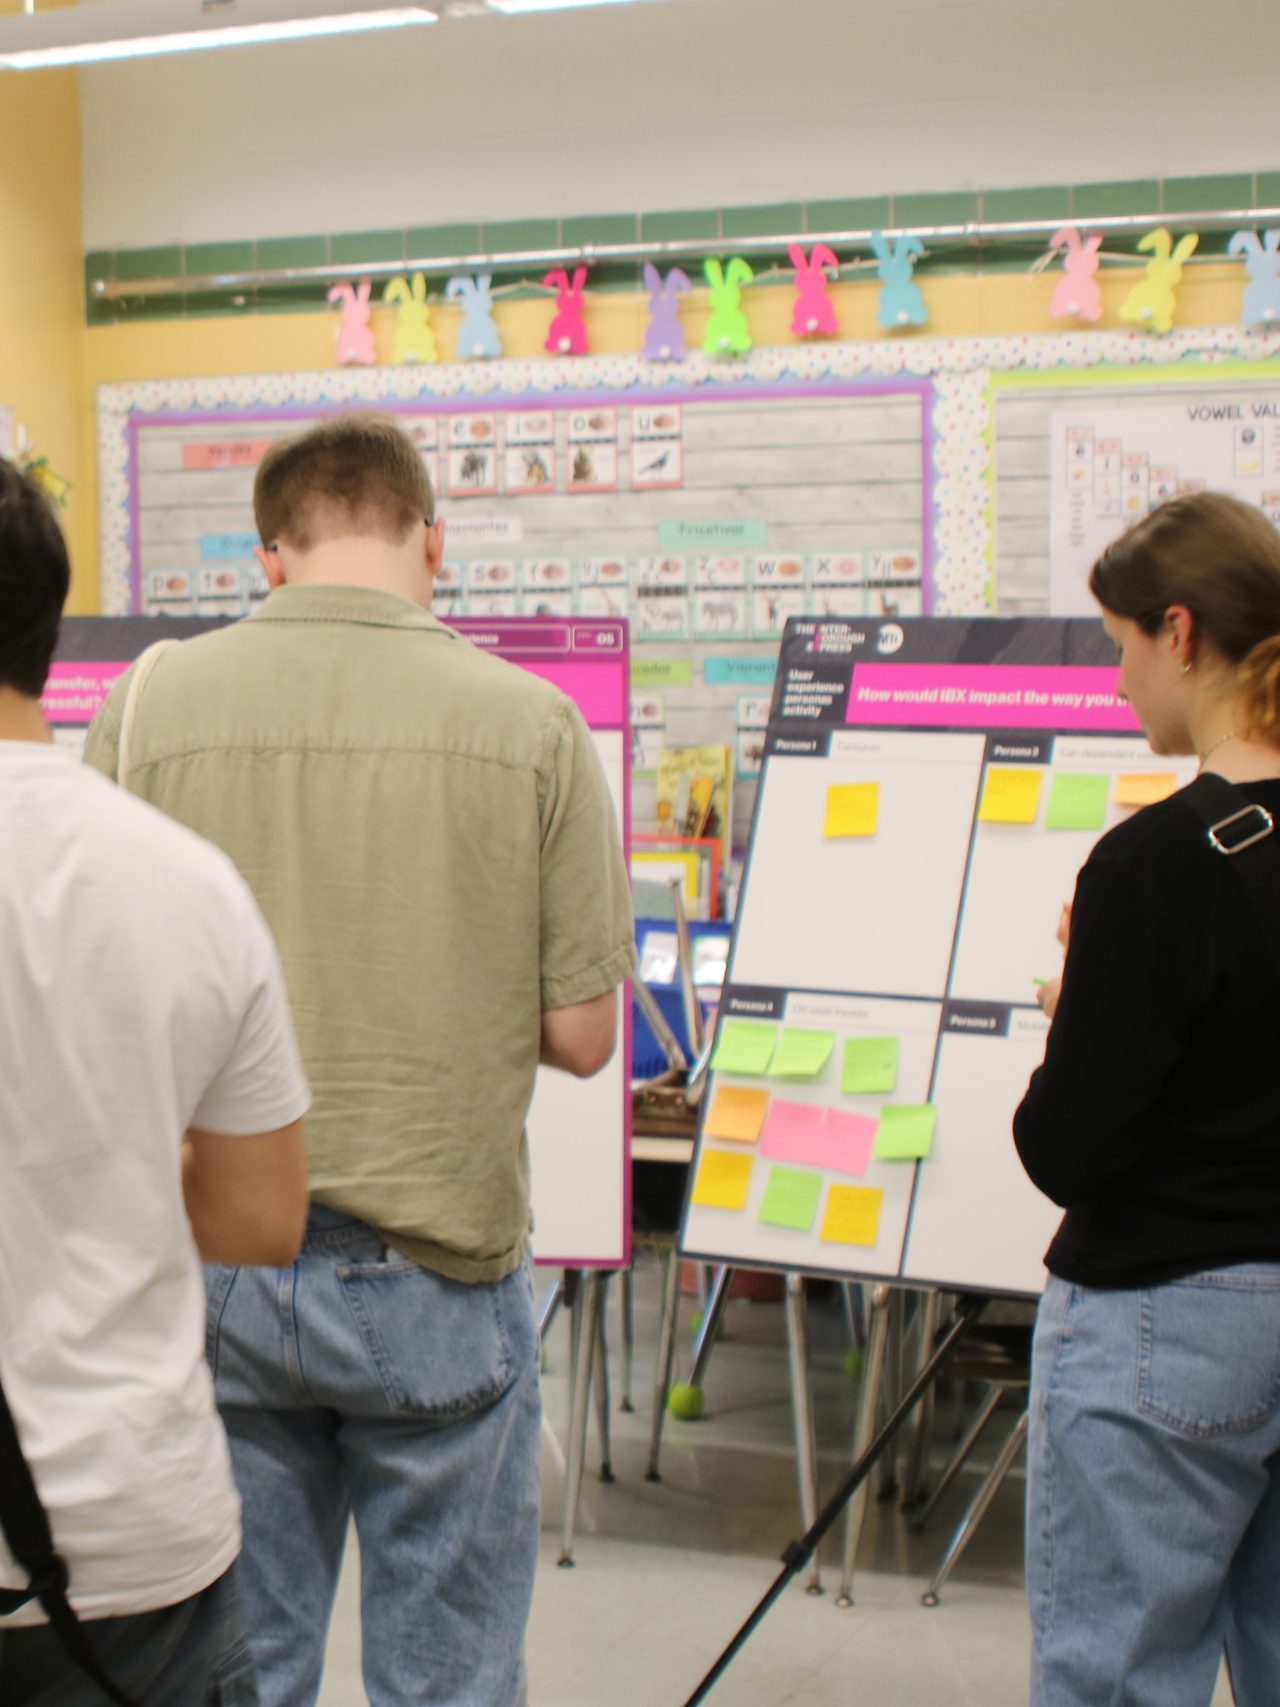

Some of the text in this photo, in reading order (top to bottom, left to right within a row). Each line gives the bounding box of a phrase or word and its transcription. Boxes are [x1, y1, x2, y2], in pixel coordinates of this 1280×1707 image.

[1188, 405, 1244, 421] VOWEL
[796, 624, 816, 635] THE
[789, 669, 814, 682] User
[45, 677, 100, 692] ransfer,
[786, 682, 845, 695] experience
[784, 694, 833, 707] personas
[858, 687, 891, 703] How
[893, 688, 937, 703] would
[939, 688, 967, 704] IBX
[969, 689, 1021, 707] impact
[1023, 689, 1049, 705] the
[1051, 693, 1082, 709] way
[1084, 694, 1114, 709] you
[781, 706, 821, 719] activity
[776, 740, 811, 751] Persona
[994, 745, 1031, 757] Persona
[731, 999, 764, 1011] Persona
[951, 1015, 989, 1027] Persona
